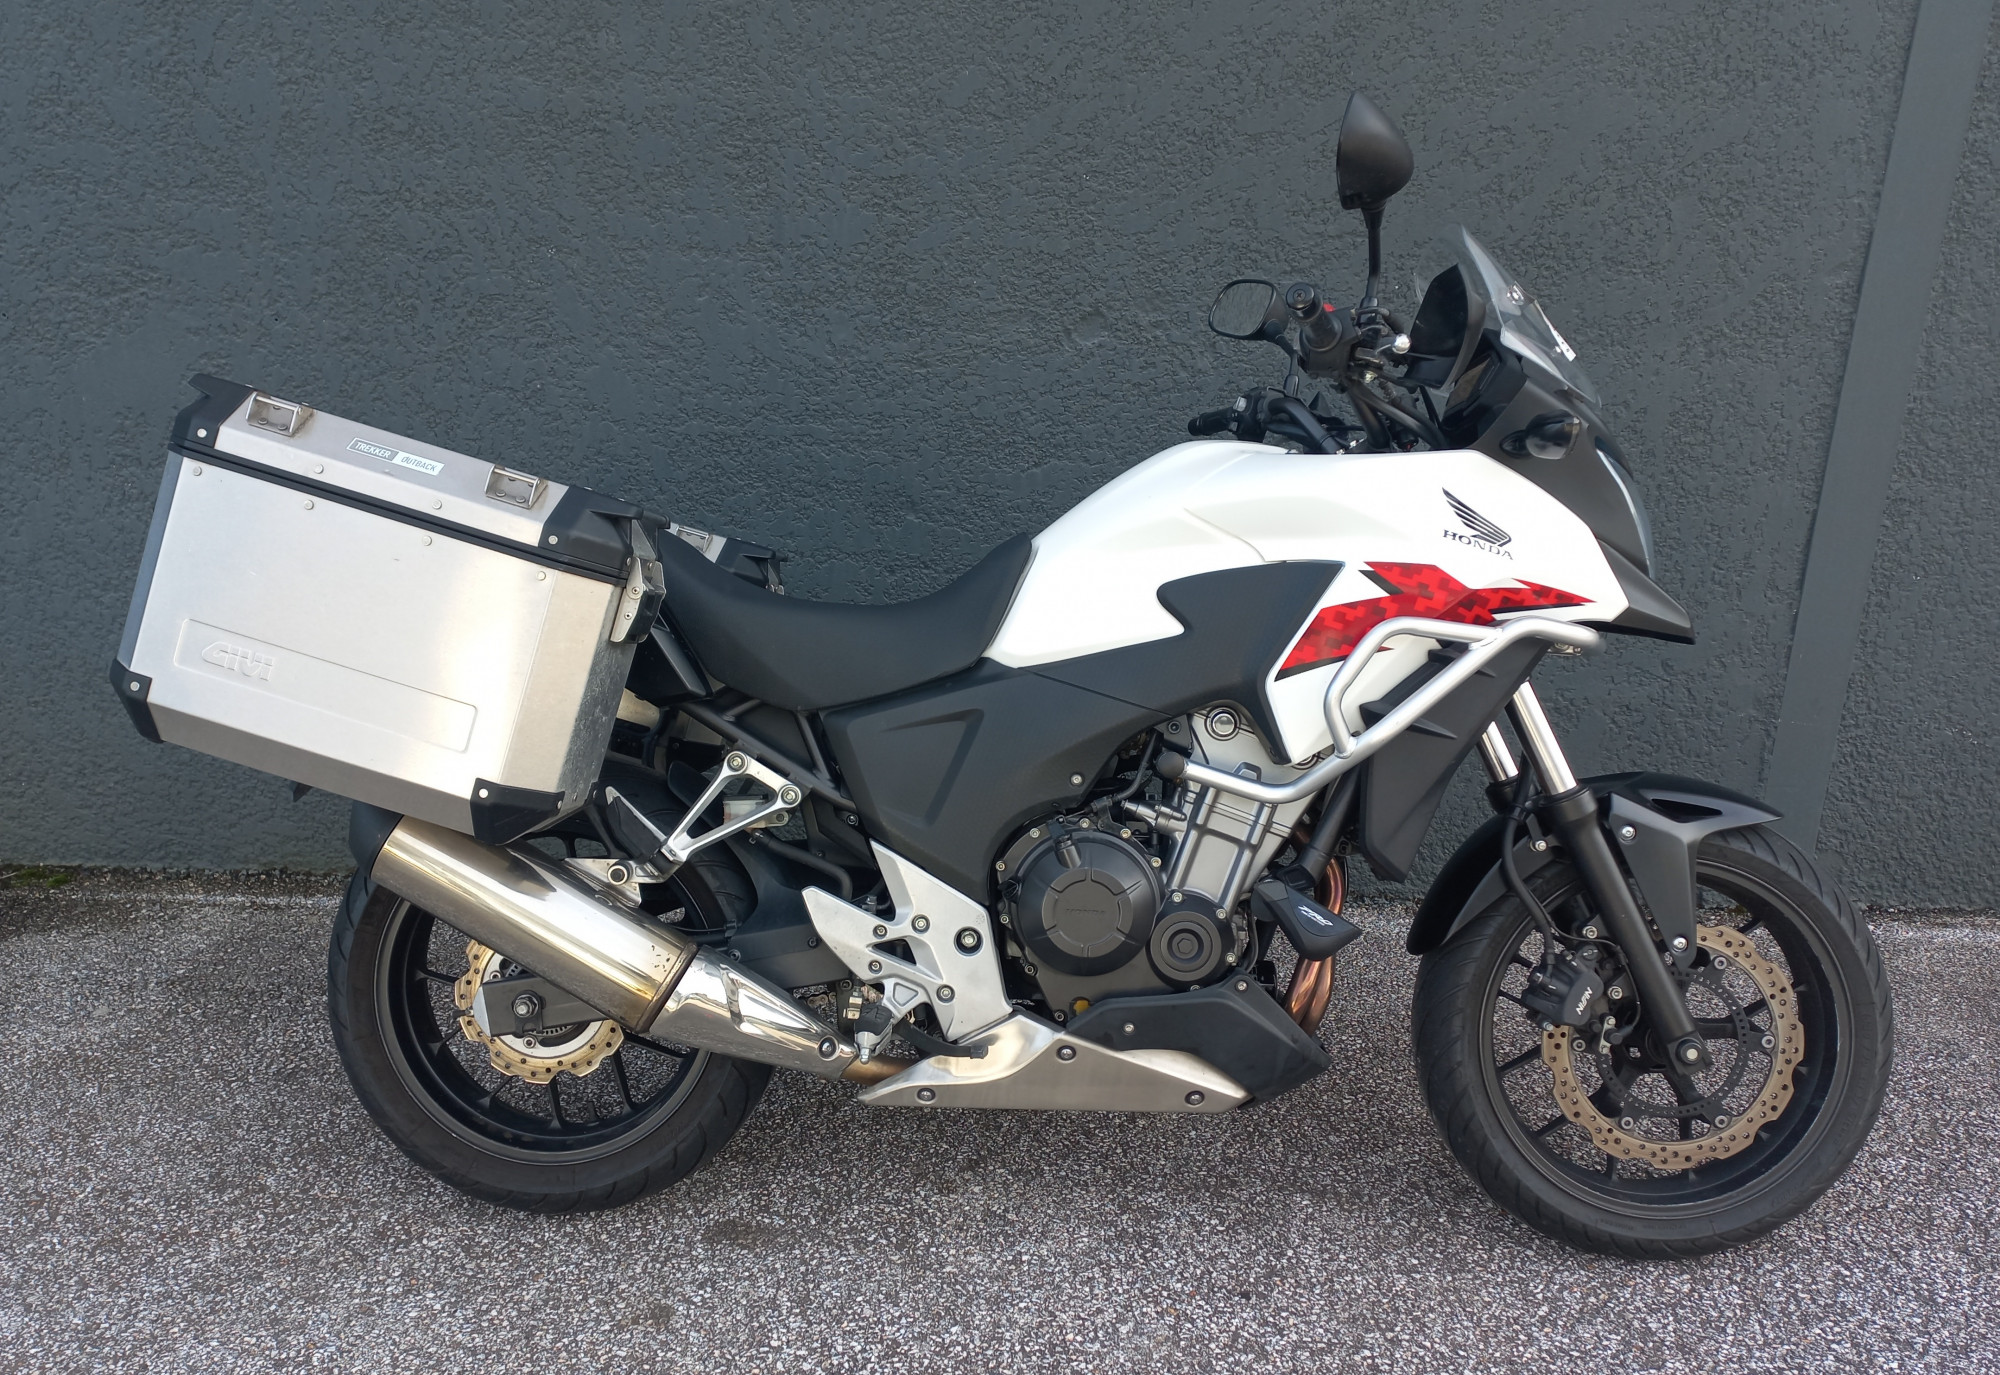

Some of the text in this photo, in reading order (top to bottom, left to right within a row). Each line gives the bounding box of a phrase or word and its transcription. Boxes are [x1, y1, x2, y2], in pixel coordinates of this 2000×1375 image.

[354, 441, 438, 473] TREKKER OUTBACK
[1443, 529, 1513, 560] HONDA
[201, 641, 275, 681] GIVI
